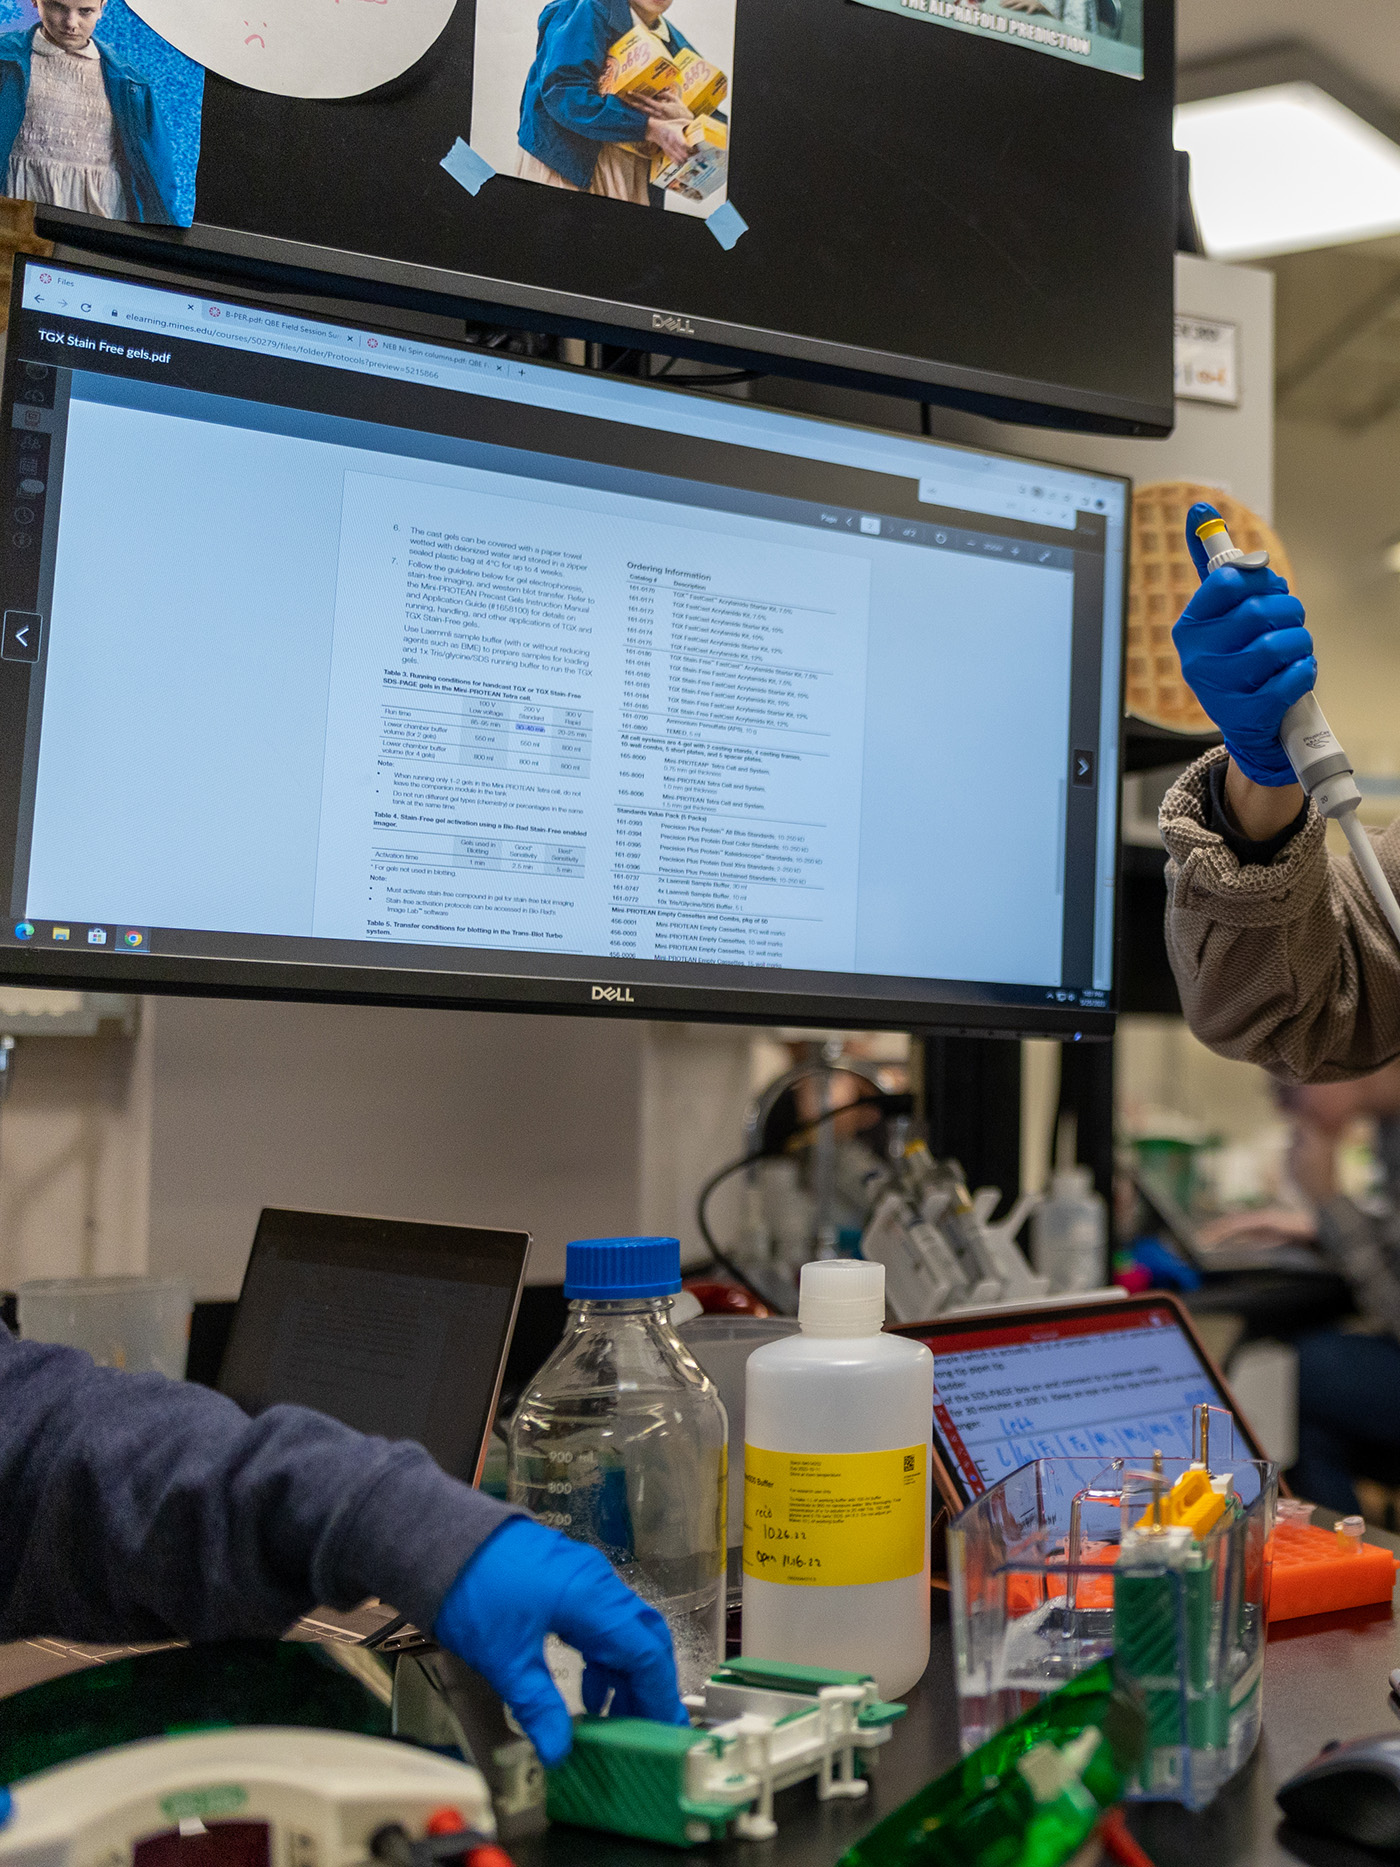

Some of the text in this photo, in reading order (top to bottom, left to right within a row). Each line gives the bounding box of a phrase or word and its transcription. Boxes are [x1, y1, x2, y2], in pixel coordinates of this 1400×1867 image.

[928, 0, 1009, 34] ALPHAFOLD
[1008, 19, 1092, 56] PREDICTION
[57, 278, 74, 286] Files
[264, 318, 280, 327] QBE
[281, 321, 299, 331] Field
[300, 324, 327, 336] Session
[652, 313, 695, 335] DELL
[38, 330, 171, 364] TGX Stain Free gels.pdf
[382, 341, 397, 350] NEB
[408, 346, 423, 356] Spin
[468, 358, 482, 368] QBE
[392, 524, 402, 532] 6.
[411, 528, 425, 536] The
[476, 537, 486, 545] be
[487, 541, 517, 550] covered
[518, 544, 533, 552] with
[540, 549, 561, 557] paper
[563, 550, 582, 559] towel
[408, 549, 434, 558] sealed
[434, 552, 459, 561] plastic
[460, 555, 475, 565] bag
[501, 561, 511, 569] for
[512, 564, 523, 572] up
[524, 564, 532, 572] to
[540, 568, 564, 576] weeks.
[409, 539, 436, 548] wetted
[436, 542, 453, 550] with
[453, 544, 490, 555] deionized
[528, 555, 551, 564] stored
[551, 558, 559, 566] in
[566, 561, 588, 571] zipper
[391, 557, 584, 594] 7. Follow the guideline below for gel electrophoresis,
[626, 561, 711, 580] Ordering Information
[406, 580, 590, 612] the Mini-PROTEAN Precast Gels Instruction Manual
[443, 576, 474, 588] imaging,
[492, 584, 521, 593] western
[522, 587, 536, 595] blot
[537, 589, 564, 599] transfer.
[567, 593, 586, 602] Refer
[422, 593, 464, 605] Application
[464, 599, 487, 608] Guide
[542, 609, 565, 619] details
[1320, 795, 1329, 805] 20
[592, 986, 635, 1003] DELL
[548, 1450, 574, 1464] 900
[548, 1482, 573, 1495] 800
[757, 1478, 775, 1489] Buffer
[546, 1513, 572, 1526] 700
